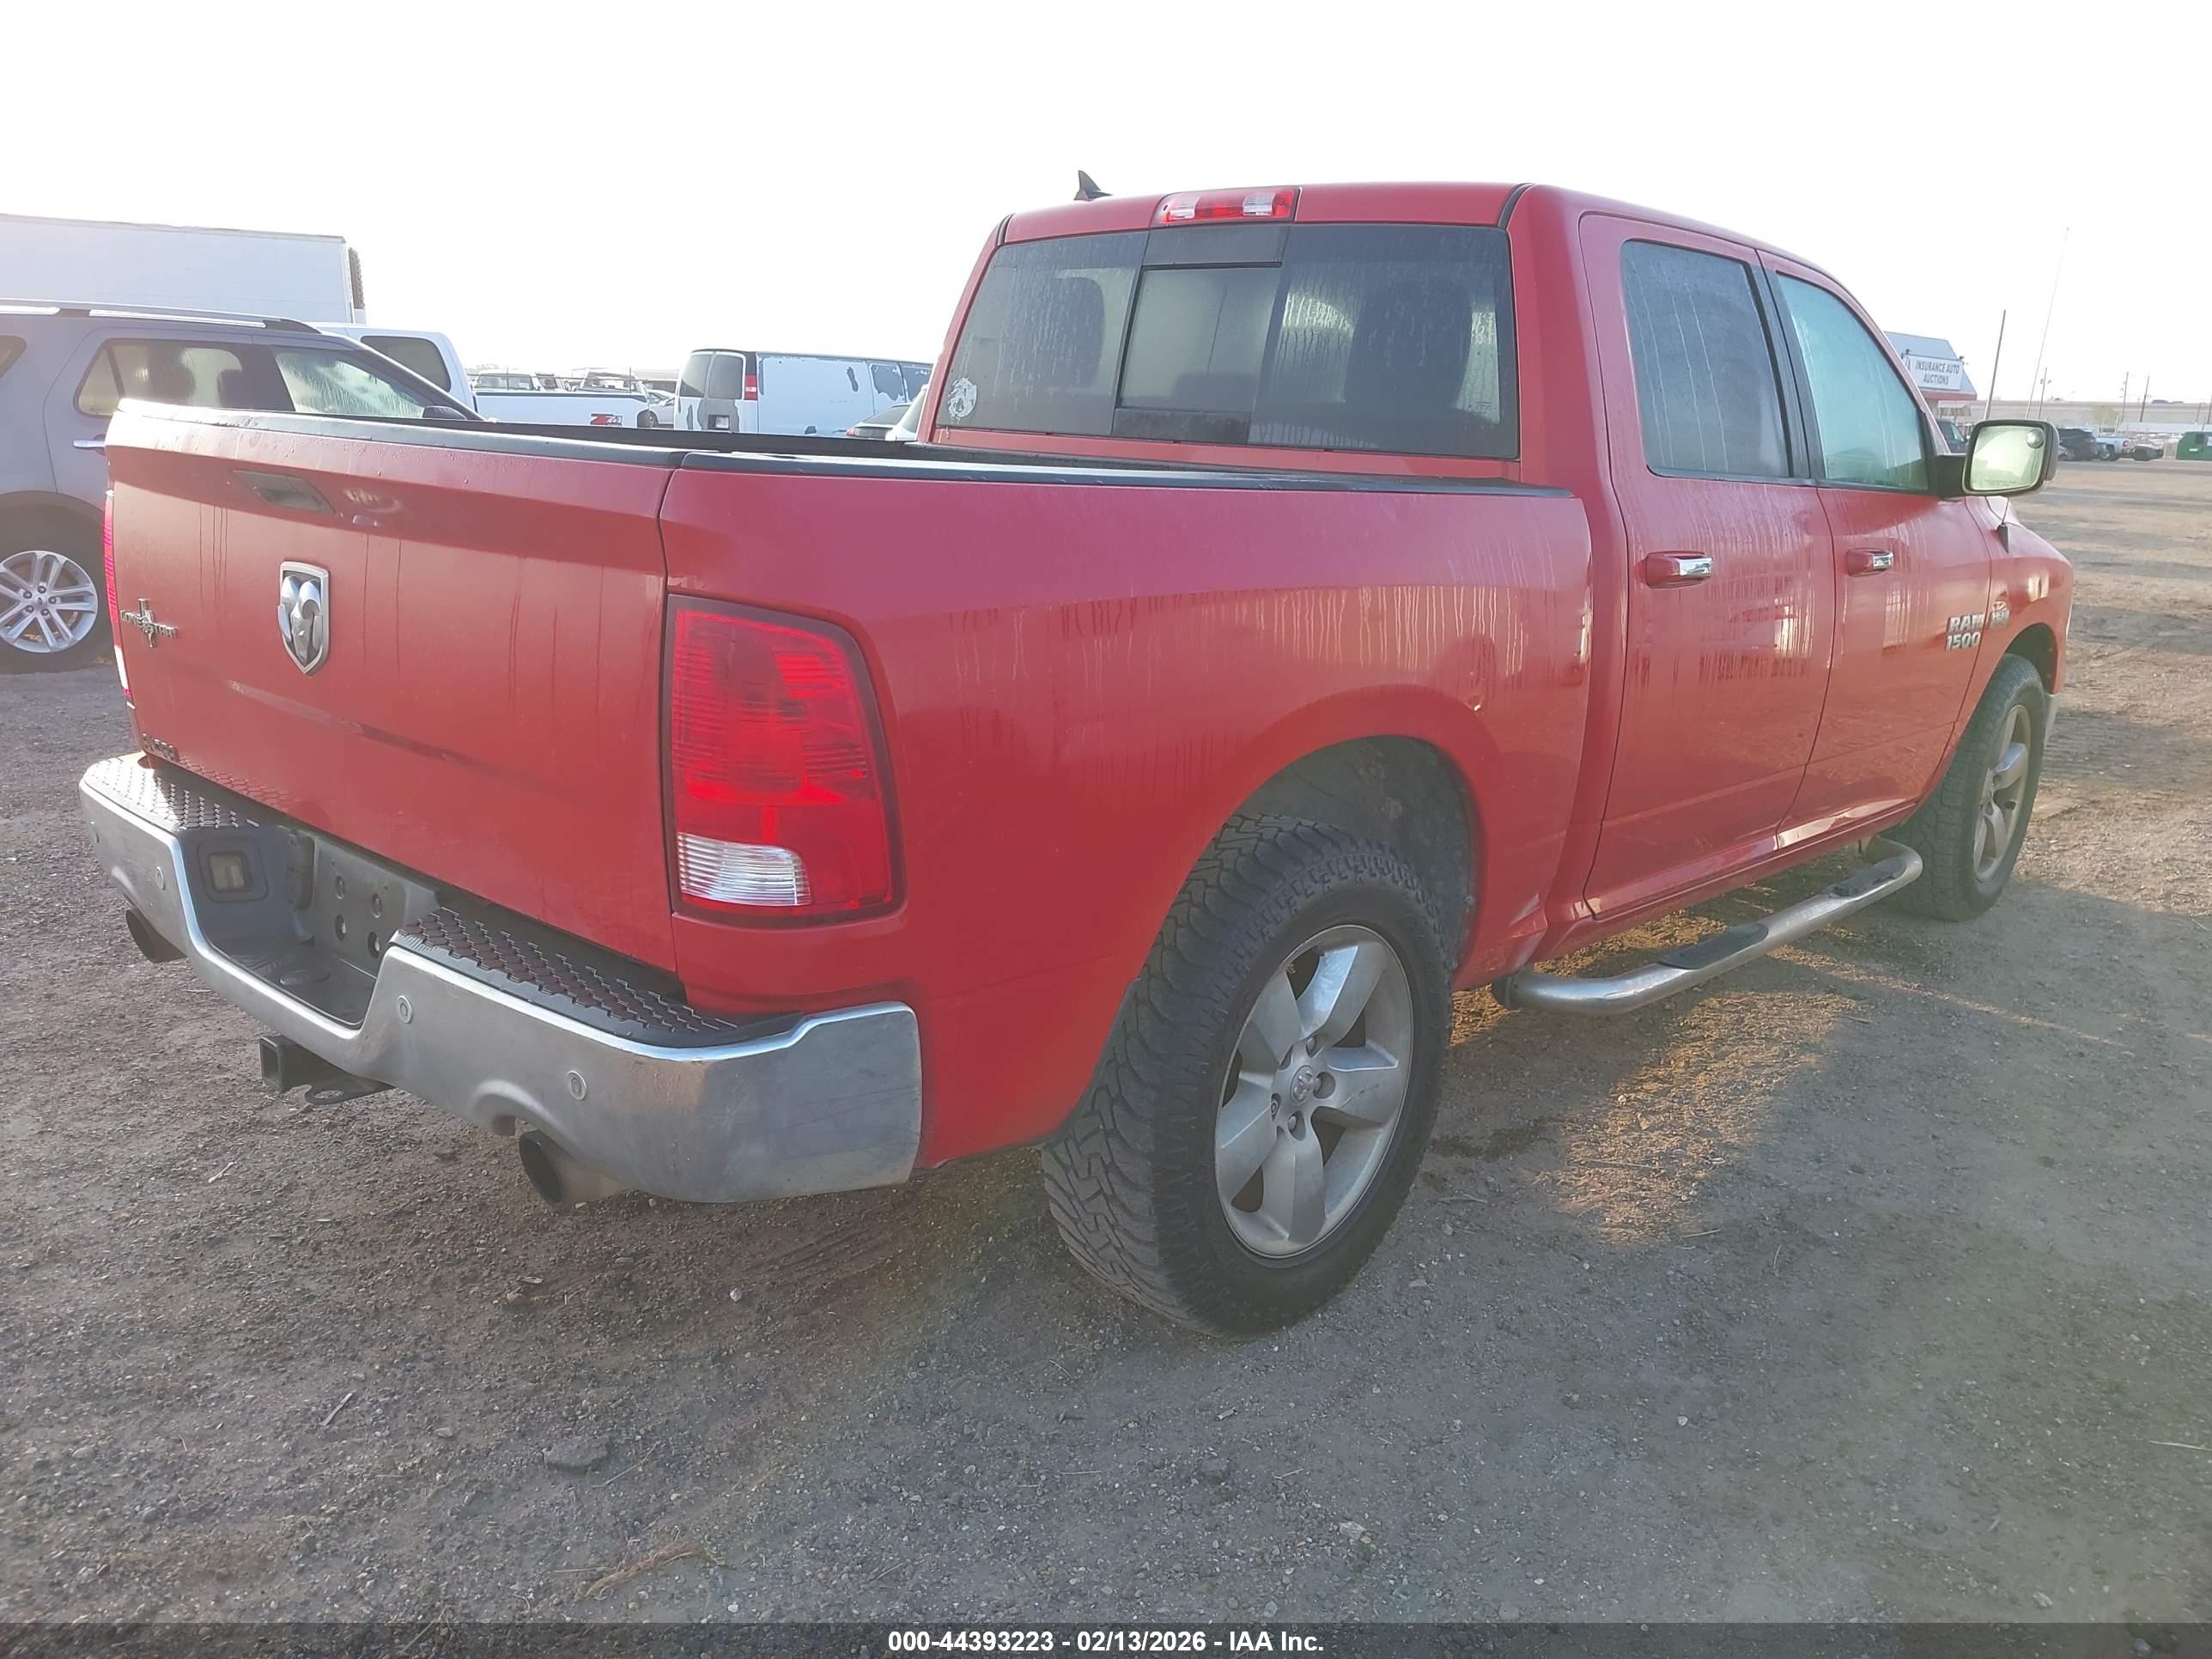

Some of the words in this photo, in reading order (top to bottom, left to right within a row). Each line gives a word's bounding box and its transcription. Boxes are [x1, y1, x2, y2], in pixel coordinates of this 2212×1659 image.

[1916, 360, 1946, 373] INSURANCE
[1946, 364, 1960, 374] AUTO
[1923, 373, 1949, 385] AUCTIONS
[1948, 613, 1984, 633] RAM
[1945, 631, 1981, 651] 1500
